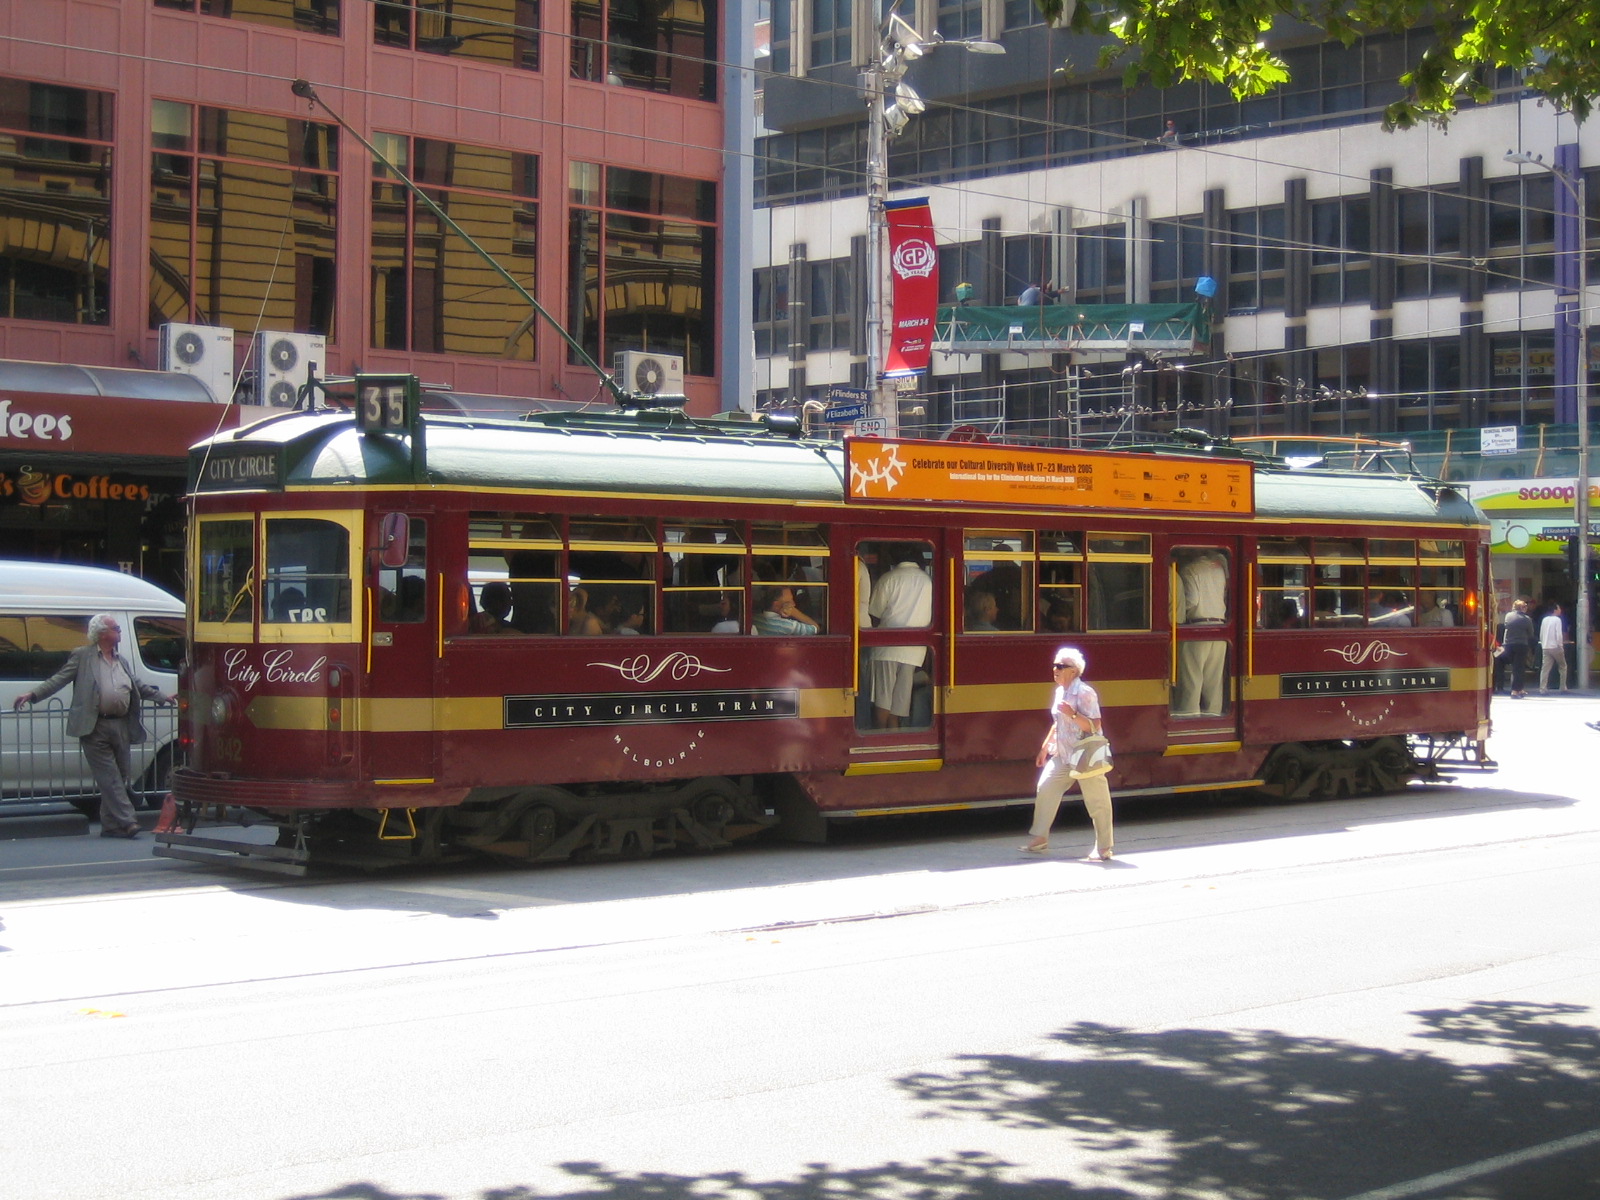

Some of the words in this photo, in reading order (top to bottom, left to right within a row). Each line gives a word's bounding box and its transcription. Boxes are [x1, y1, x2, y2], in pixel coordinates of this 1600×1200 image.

[902, 249, 925, 265] GP
[898, 320, 919, 328] MARCH
[835, 389, 860, 399] Flinders
[860, 391, 868, 400] St
[366, 386, 404, 425] 35
[830, 407, 859, 418] Elizabeth
[860, 421, 880, 432] END
[210, 458, 236, 480] CITY
[239, 455, 276, 477] CIRCLE
[912, 458, 945, 469] Celebrate
[946, 460, 958, 469] our
[959, 459, 986, 470] Cultural
[987, 460, 1015, 472] Diversity
[1016, 462, 1035, 472] Week
[1057, 463, 1077, 473] March
[1077, 464, 1093, 474] 2005
[54, 473, 150, 501] Coffees
[1518, 486, 1575, 504] scoop
[224, 648, 261, 692] City
[262, 649, 327, 683] Circle
[1296, 681, 1331, 690] CITY
[1342, 678, 1392, 688] CIRCLE
[1401, 676, 1437, 686] TRAM
[534, 705, 593, 718] CITY
[614, 702, 699, 715] CIRCLE
[718, 699, 775, 712] TRAM
[1340, 700, 1395, 726] MELBOURNE
[614, 729, 705, 768] MELBOURNE
